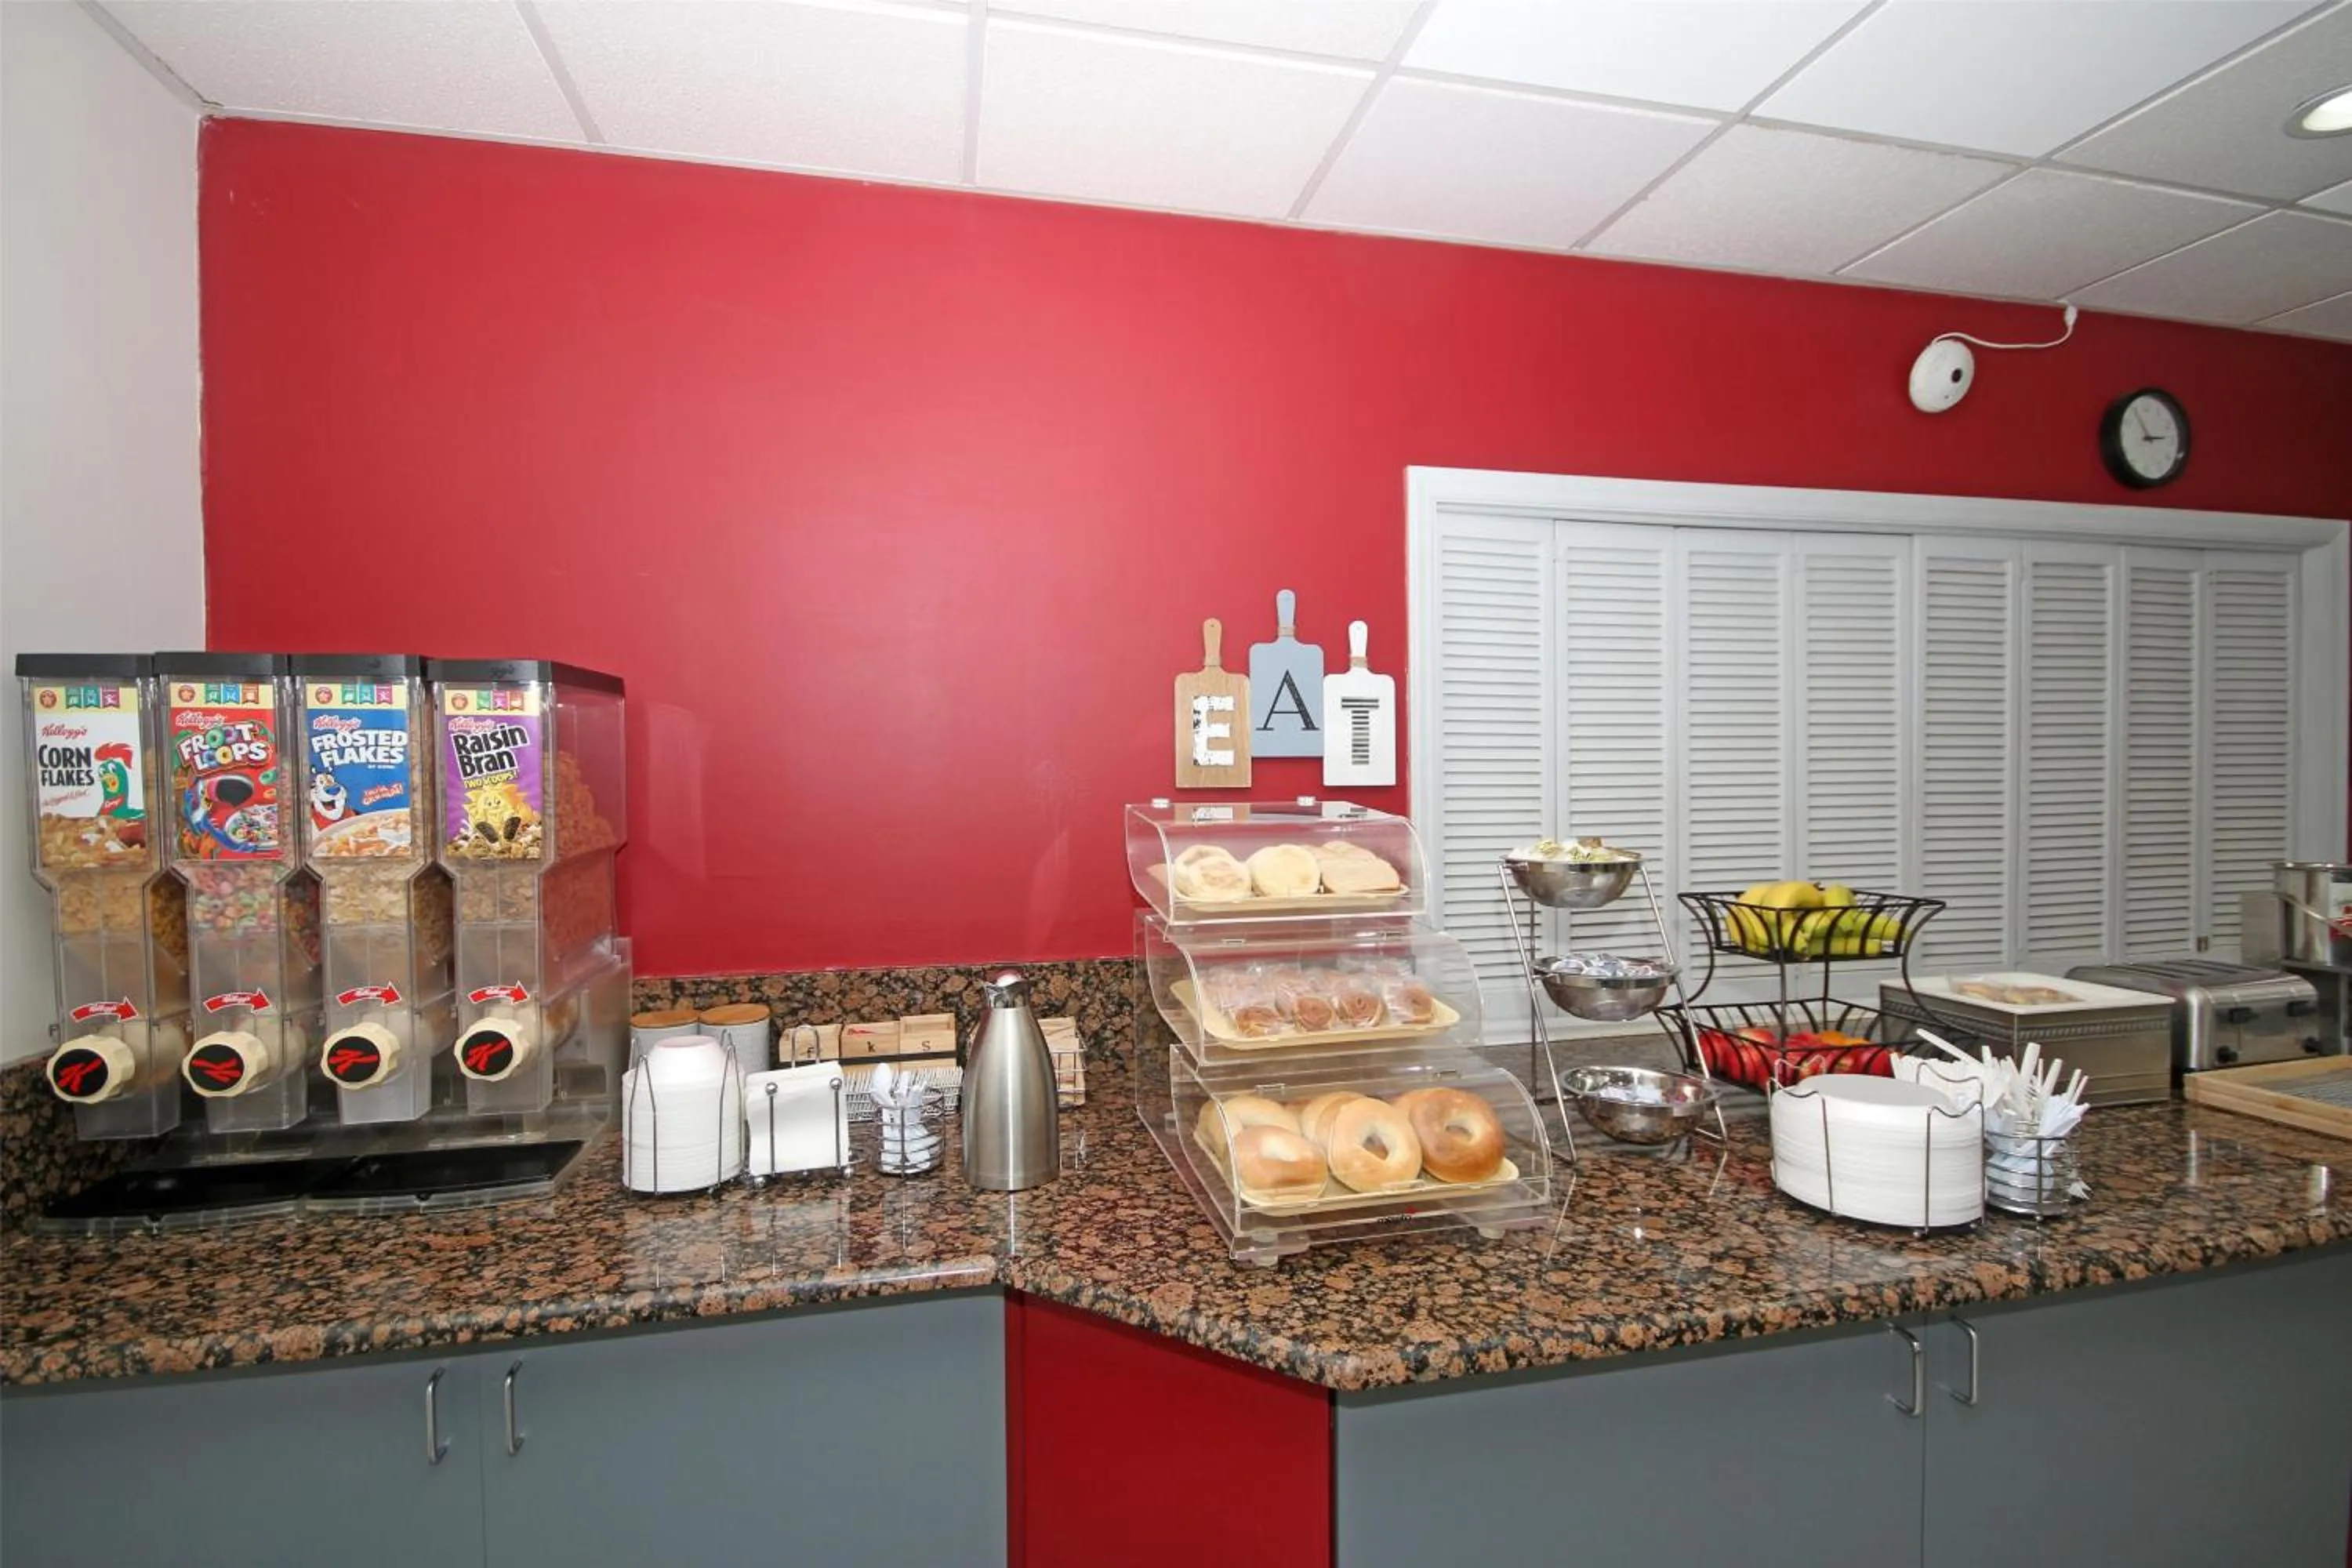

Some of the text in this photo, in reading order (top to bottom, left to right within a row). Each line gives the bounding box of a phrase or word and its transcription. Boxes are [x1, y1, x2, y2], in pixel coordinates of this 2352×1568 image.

[42, 724, 87, 739] Kellogg's
[180, 723, 253, 760] FROOT
[311, 729, 408, 753] FROSTED
[452, 724, 528, 756] Raisin
[38, 744, 92, 768] CORN
[194, 742, 267, 771] LOOPS
[321, 746, 405, 768] FLAKES
[459, 750, 517, 778] Bran
[42, 769, 95, 786] FLAKES
